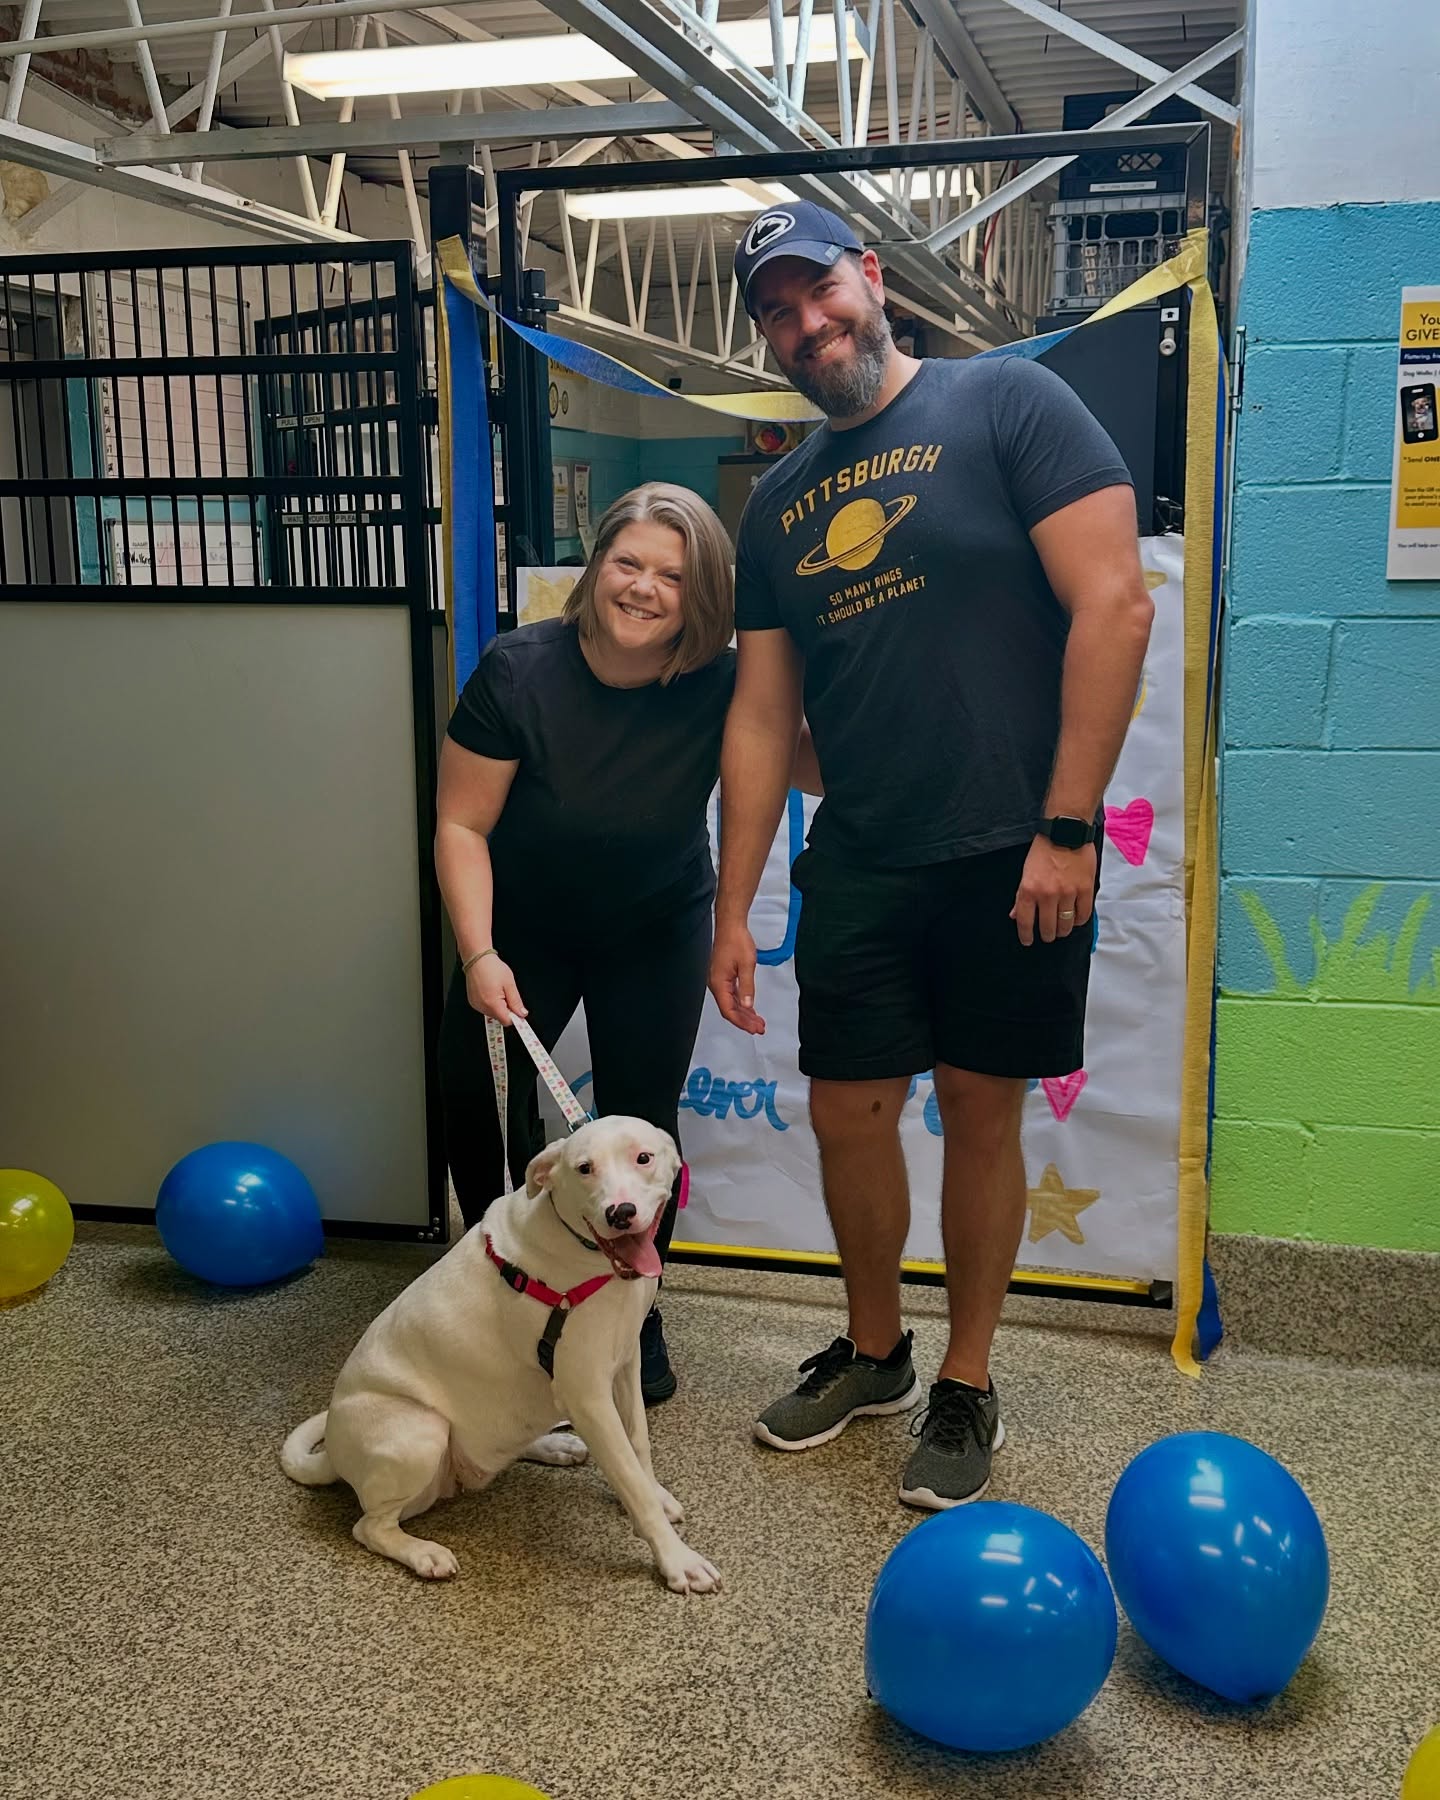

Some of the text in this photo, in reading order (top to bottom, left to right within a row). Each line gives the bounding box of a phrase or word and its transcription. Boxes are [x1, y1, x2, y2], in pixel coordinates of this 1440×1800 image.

[1406, 328, 1440, 341] GIVE
[304, 416, 321, 424] OPEN
[780, 444, 943, 535] PITTSBURGH
[816, 575, 926, 626] IT SHOULD BE A PLANET
[829, 567, 903, 606] SO MANY RINGS
